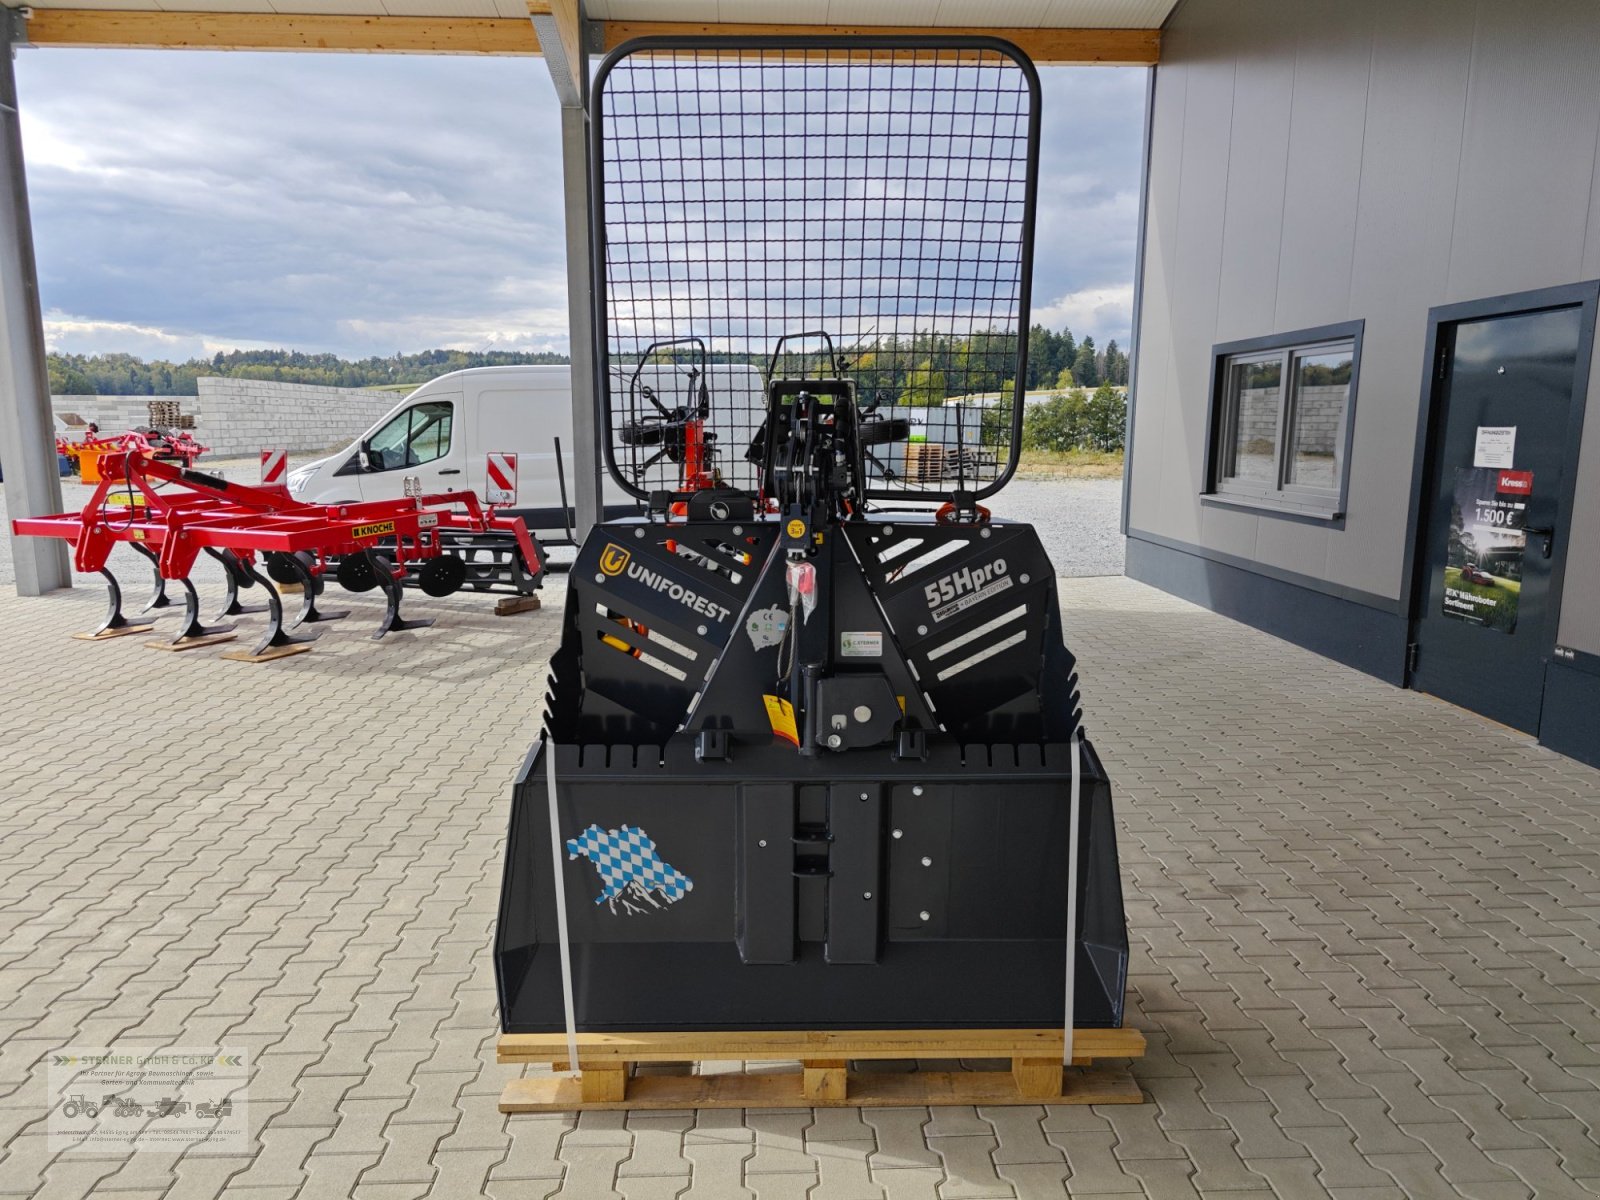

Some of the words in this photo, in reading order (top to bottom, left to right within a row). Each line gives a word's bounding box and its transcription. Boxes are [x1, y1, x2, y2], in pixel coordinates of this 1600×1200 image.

[361, 523, 394, 536] KNOCHE
[1475, 508, 1505, 524] 1.500
[1506, 511, 1515, 525] €
[627, 561, 731, 623] UNIFOREST
[924, 558, 1007, 609] 55Hpro
